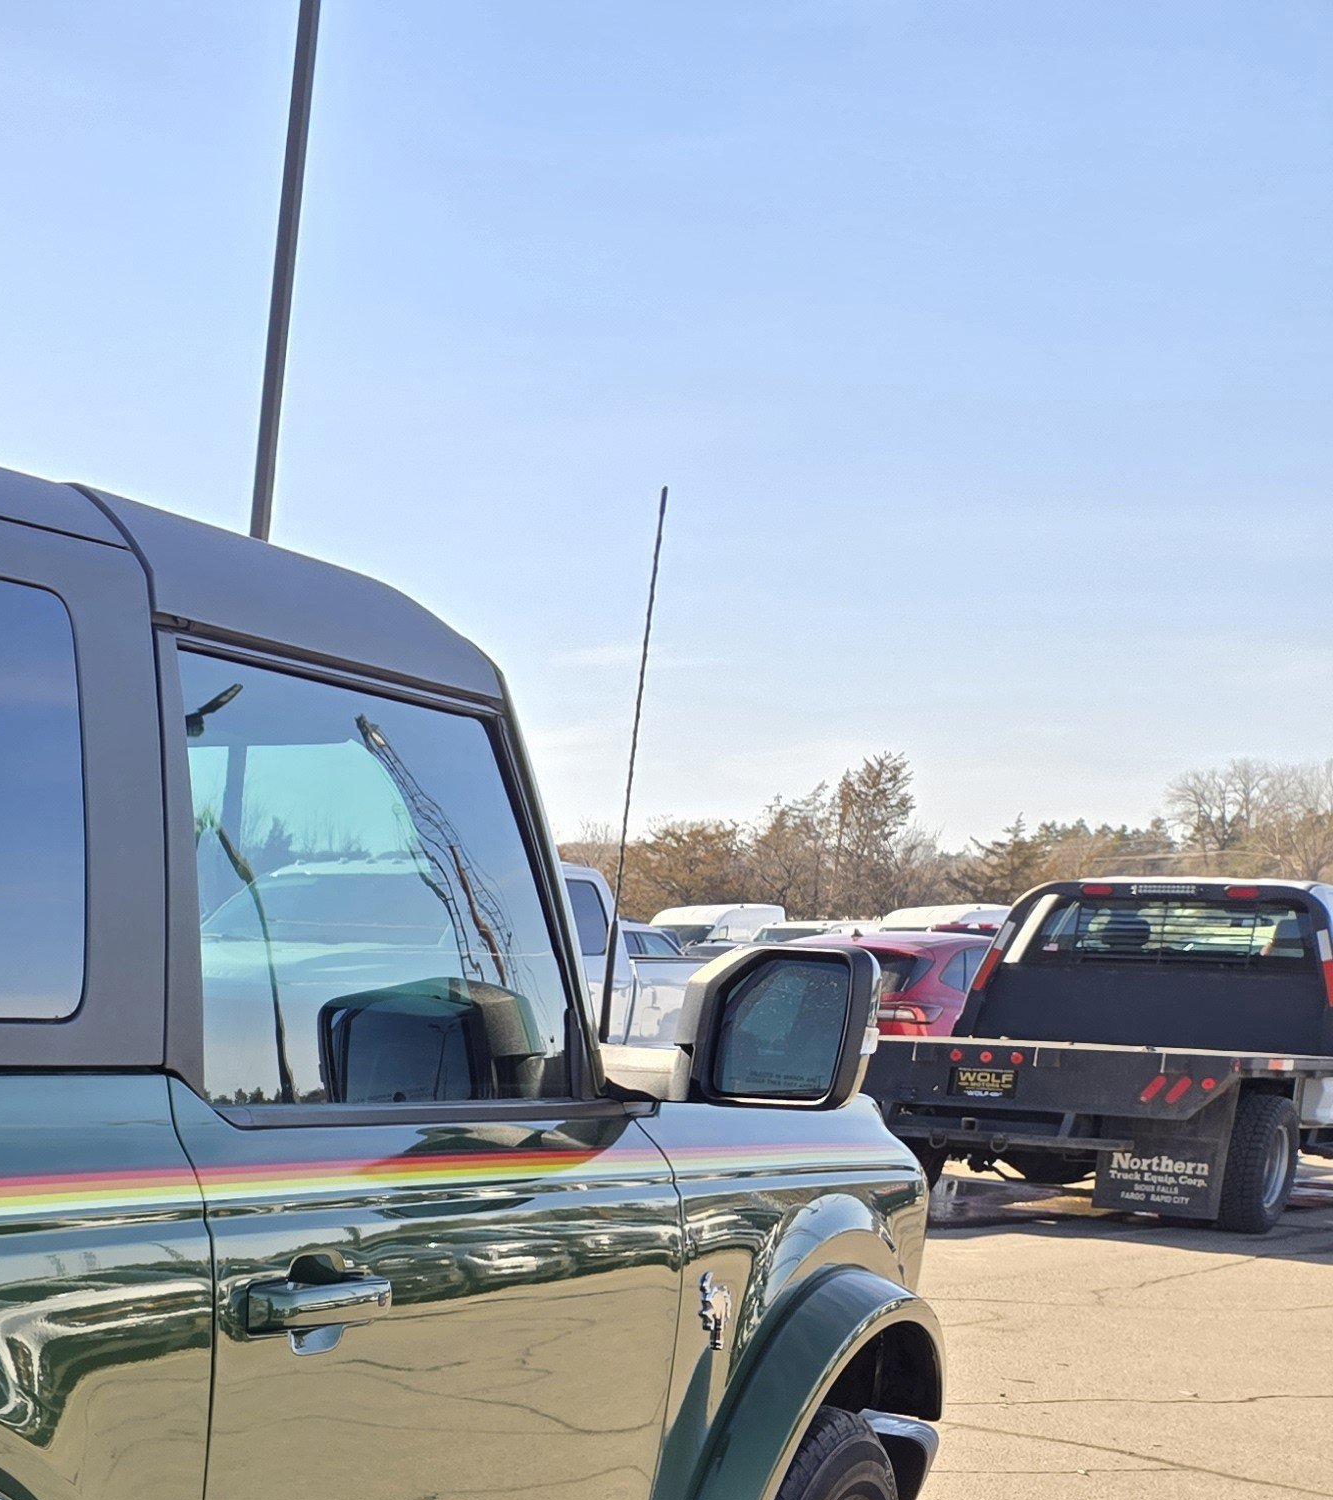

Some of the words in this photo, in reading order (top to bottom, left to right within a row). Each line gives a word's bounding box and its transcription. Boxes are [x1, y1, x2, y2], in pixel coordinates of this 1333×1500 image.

[959, 1071, 1014, 1084] WOLF
[1110, 1152, 1209, 1176] Northern
[1109, 1170, 1141, 1180] Truck
[1144, 1173, 1178, 1185] Equip.
[1179, 1176, 1208, 1187] Corp.
